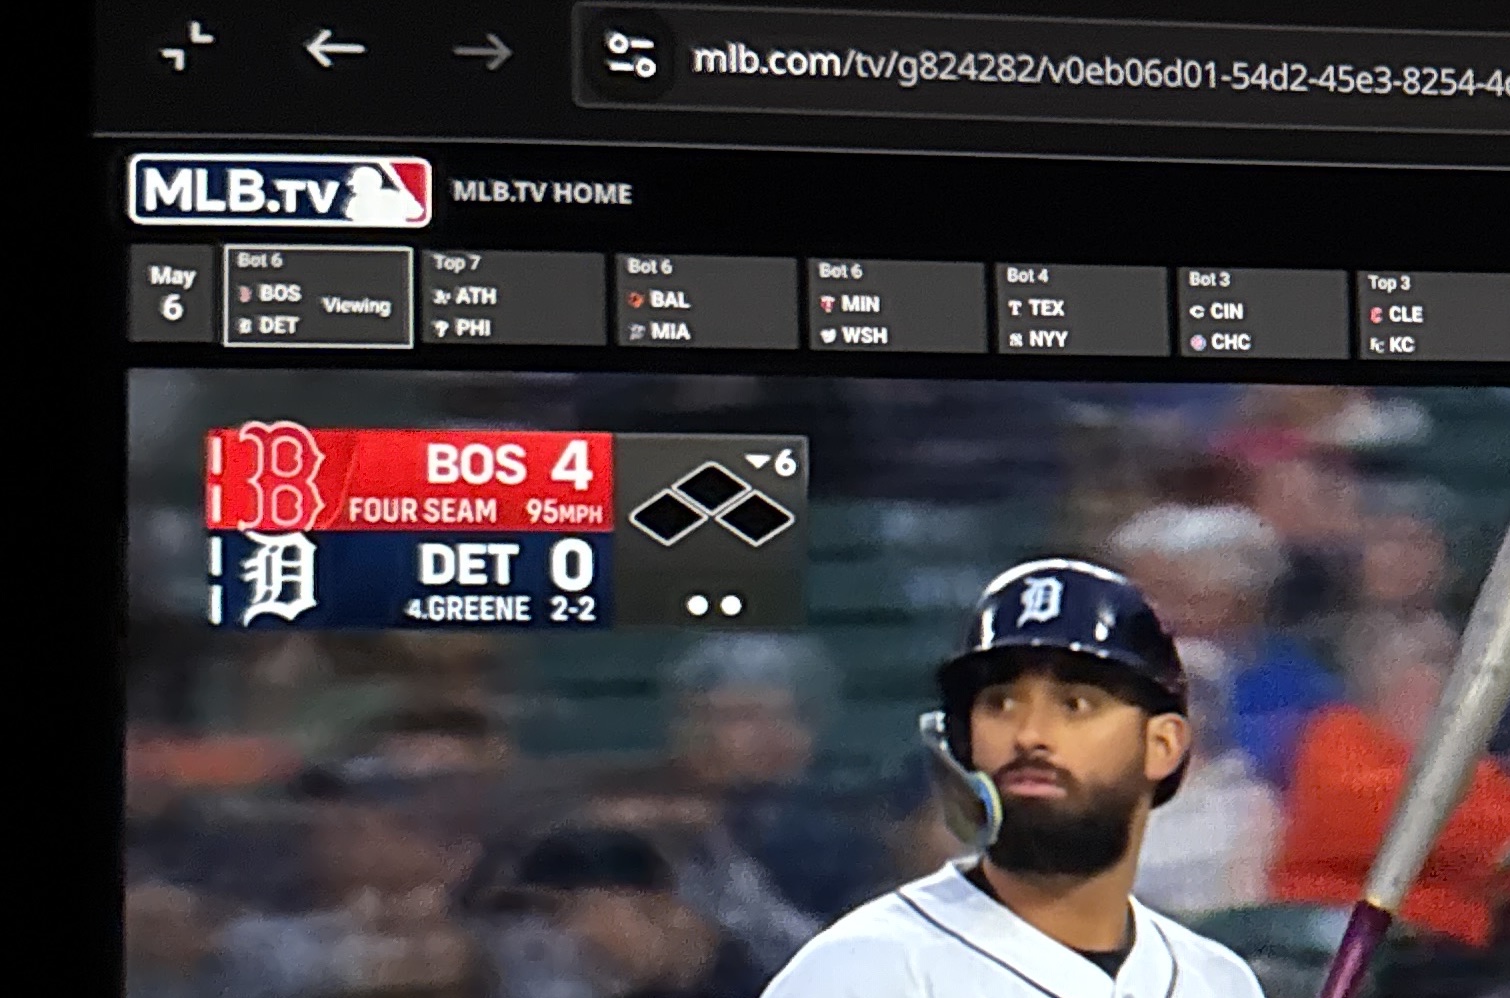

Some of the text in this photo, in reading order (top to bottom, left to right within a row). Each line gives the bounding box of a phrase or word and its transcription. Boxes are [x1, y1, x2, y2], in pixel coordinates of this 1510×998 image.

[144, 168, 339, 214] MLB.TV
[453, 180, 632, 204] MLB.TV HOME
[234, 248, 285, 267] Bot 6
[433, 254, 481, 273] Top 7
[628, 258, 672, 274] Bot 6
[150, 266, 196, 289] May
[819, 262, 862, 279] Bot 6
[1007, 267, 1048, 283] Bot 4
[1190, 271, 1230, 287] Bot 3
[259, 284, 302, 301] BOS
[1368, 275, 1410, 293] Top 3
[456, 286, 496, 304] ATH
[650, 290, 690, 308] BAL
[842, 295, 880, 312] MIN
[162, 294, 183, 320] 6
[322, 297, 391, 317] Viewing
[1029, 299, 1064, 316] TEX
[1210, 303, 1243, 319] CIN
[1389, 306, 1423, 322] CLE
[259, 316, 299, 333] DET
[455, 319, 490, 336] PHI
[651, 323, 690, 340] MIA
[842, 327, 887, 343] WSH
[1030, 330, 1068, 347] NYY
[1212, 333, 1251, 350] CHC
[1390, 336, 1414, 352] KC
[427, 440, 594, 490] BOS 4
[775, 450, 796, 476] 6
[348, 498, 602, 525] FOUR SEAM 95MPH
[420, 538, 594, 591] DET 0
[407, 595, 595, 621] 4.GREENE 2-2
